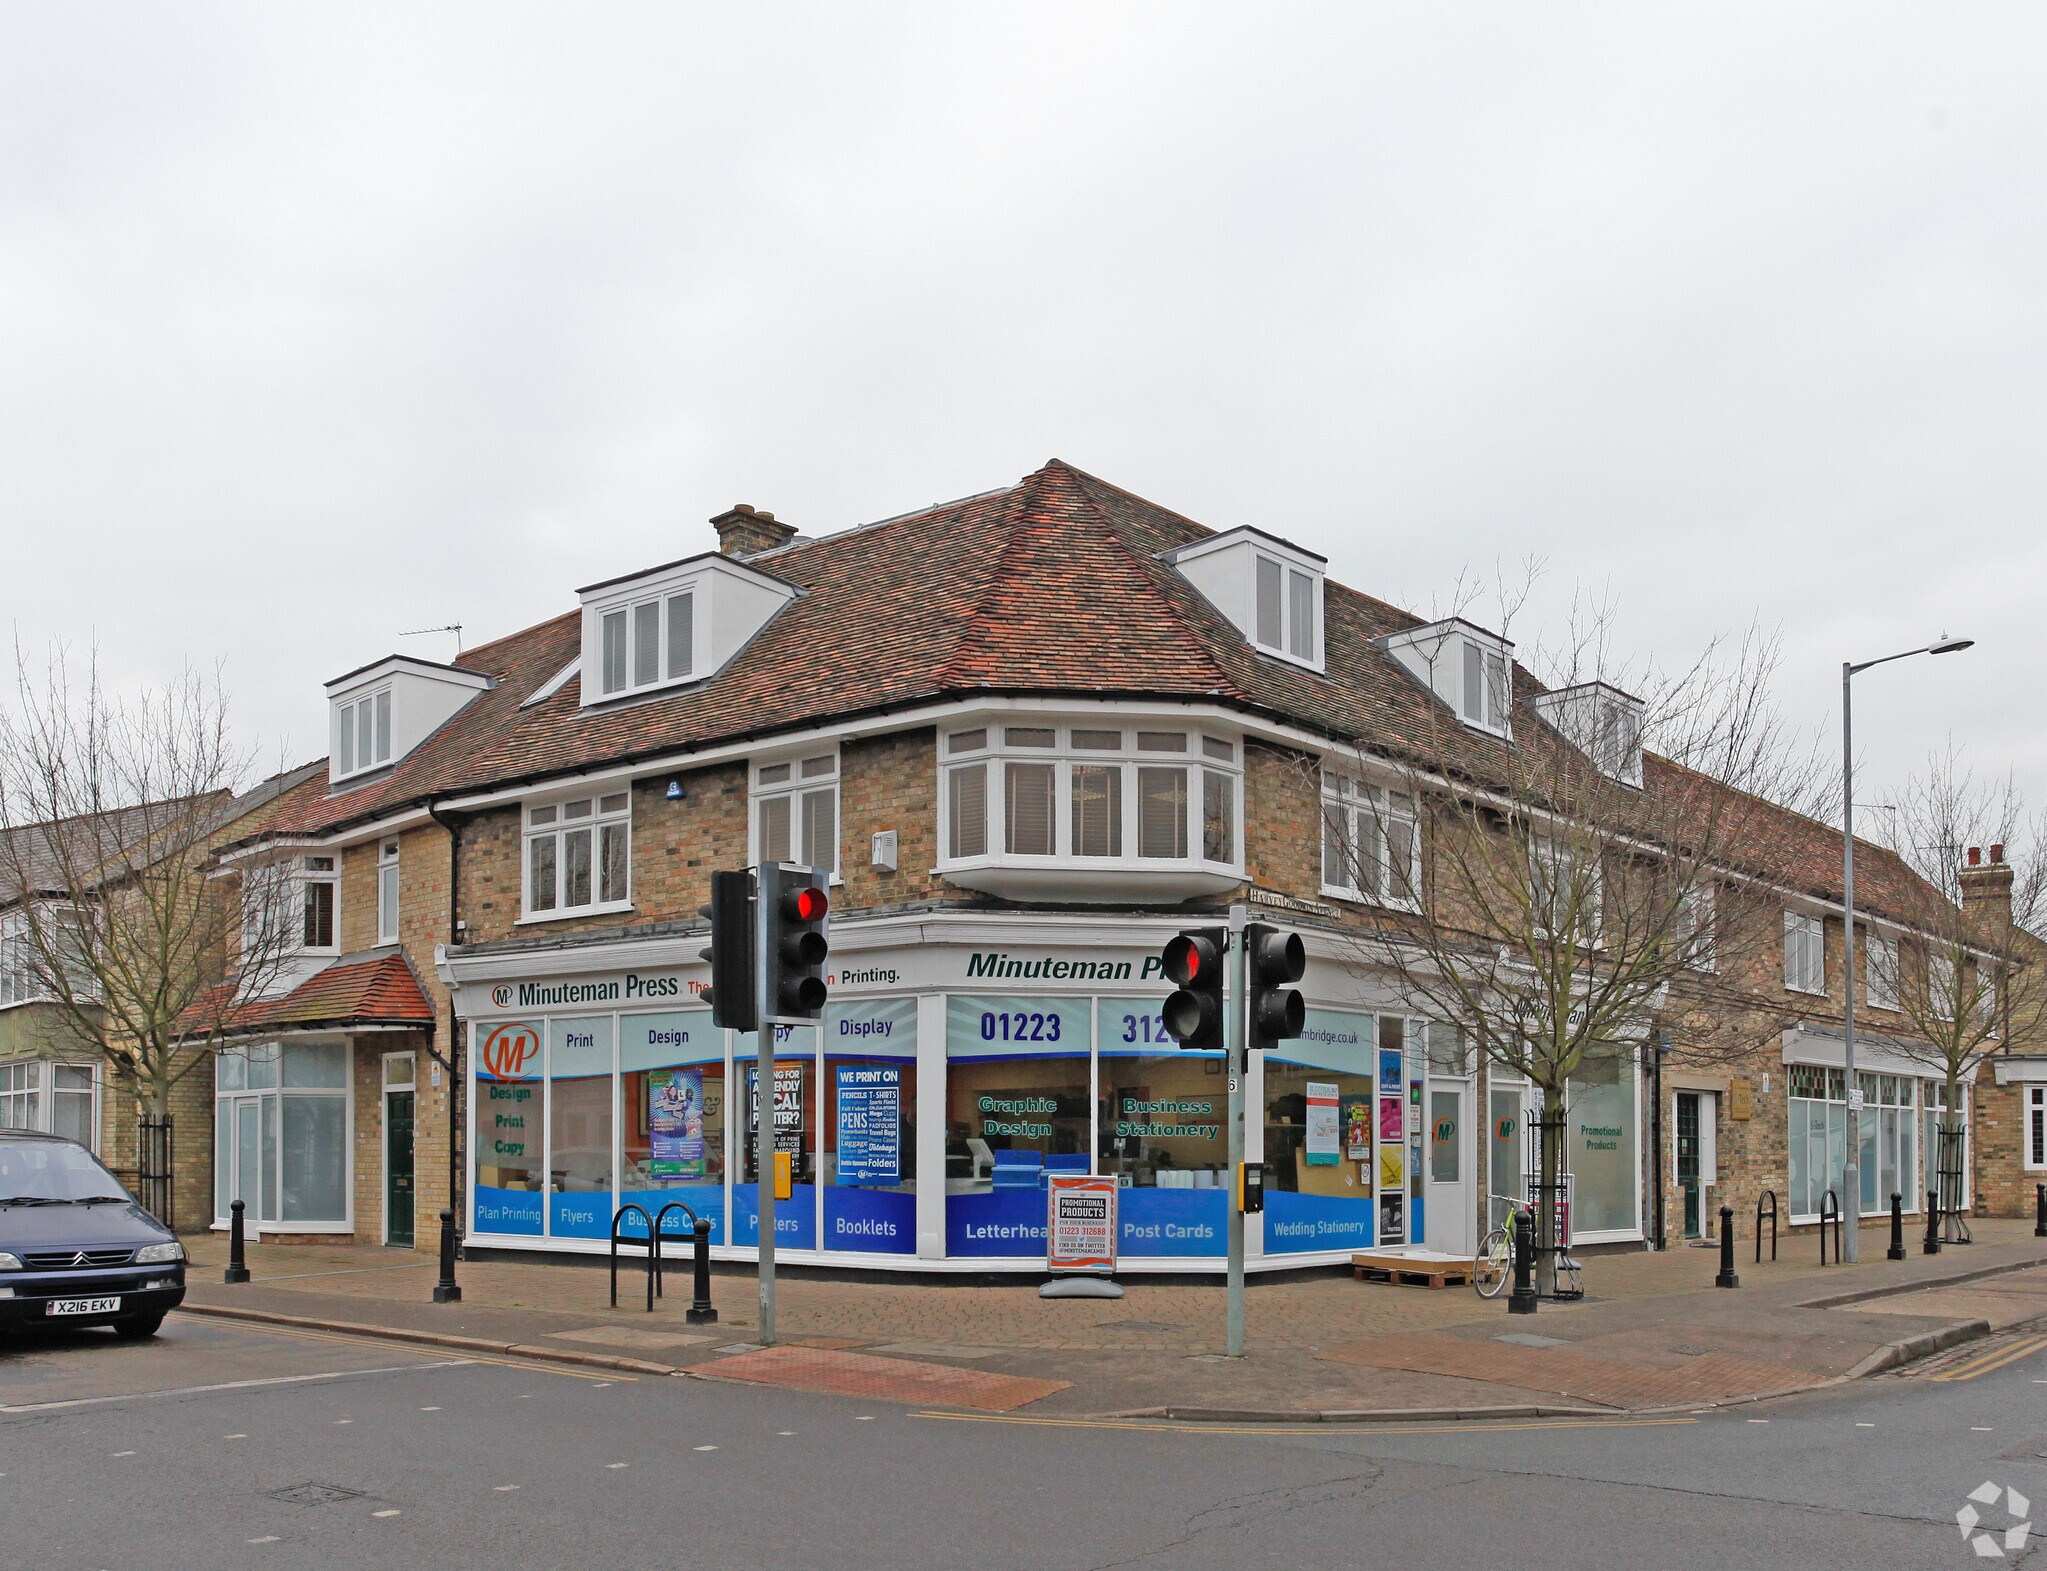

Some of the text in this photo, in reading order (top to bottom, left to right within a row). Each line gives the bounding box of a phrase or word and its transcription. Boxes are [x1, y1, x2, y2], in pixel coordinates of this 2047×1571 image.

[966, 953, 1132, 979] Minuteman
[519, 982, 619, 1007] Minuteman
[626, 974, 678, 998] Press
[687, 980, 710, 994] The
[842, 967, 900, 985] Printing.
[840, 1019, 893, 1038] Display
[981, 1012, 1061, 1042] 01223
[566, 1033, 594, 1048] Print
[648, 1029, 689, 1047] Design
[785, 1070, 800, 1079] FOR
[840, 1070, 898, 1083] WE PRINT ON
[1229, 1079, 1235, 1091] 6
[489, 1085, 531, 1103] Design
[752, 1092, 800, 1111] LCAL
[841, 1091, 868, 1099] PENCILS
[868, 1090, 897, 1099] T-SHIRTS
[978, 1096, 1058, 1115] Graphic
[1123, 1098, 1212, 1114] Business
[495, 1114, 525, 1128] Print
[841, 1112, 868, 1129] PENS
[984, 1120, 1052, 1140] Design
[1116, 1121, 1219, 1140] Stationery
[1581, 1124, 1623, 1137] Promotional
[494, 1139, 525, 1156] Copy
[840, 1139, 869, 1148] Luggage
[1586, 1139, 1617, 1151] Products
[868, 1158, 897, 1168] Folders
[1061, 1199, 1105, 1207] PROMOTIONAL
[477, 1205, 541, 1225] Plan Printing
[561, 1208, 594, 1226] Flyers
[1061, 1207, 1105, 1218] PRODUCTS
[749, 1214, 799, 1231] Pters
[836, 1217, 897, 1236] Booklets
[1059, 1226, 1080, 1235] 01223
[1274, 1220, 1364, 1237] Wedding Stationery
[966, 1224, 1047, 1239] Letterhea
[1124, 1223, 1213, 1239] Post Cards
[58, 1299, 116, 1313] X216 EKV
